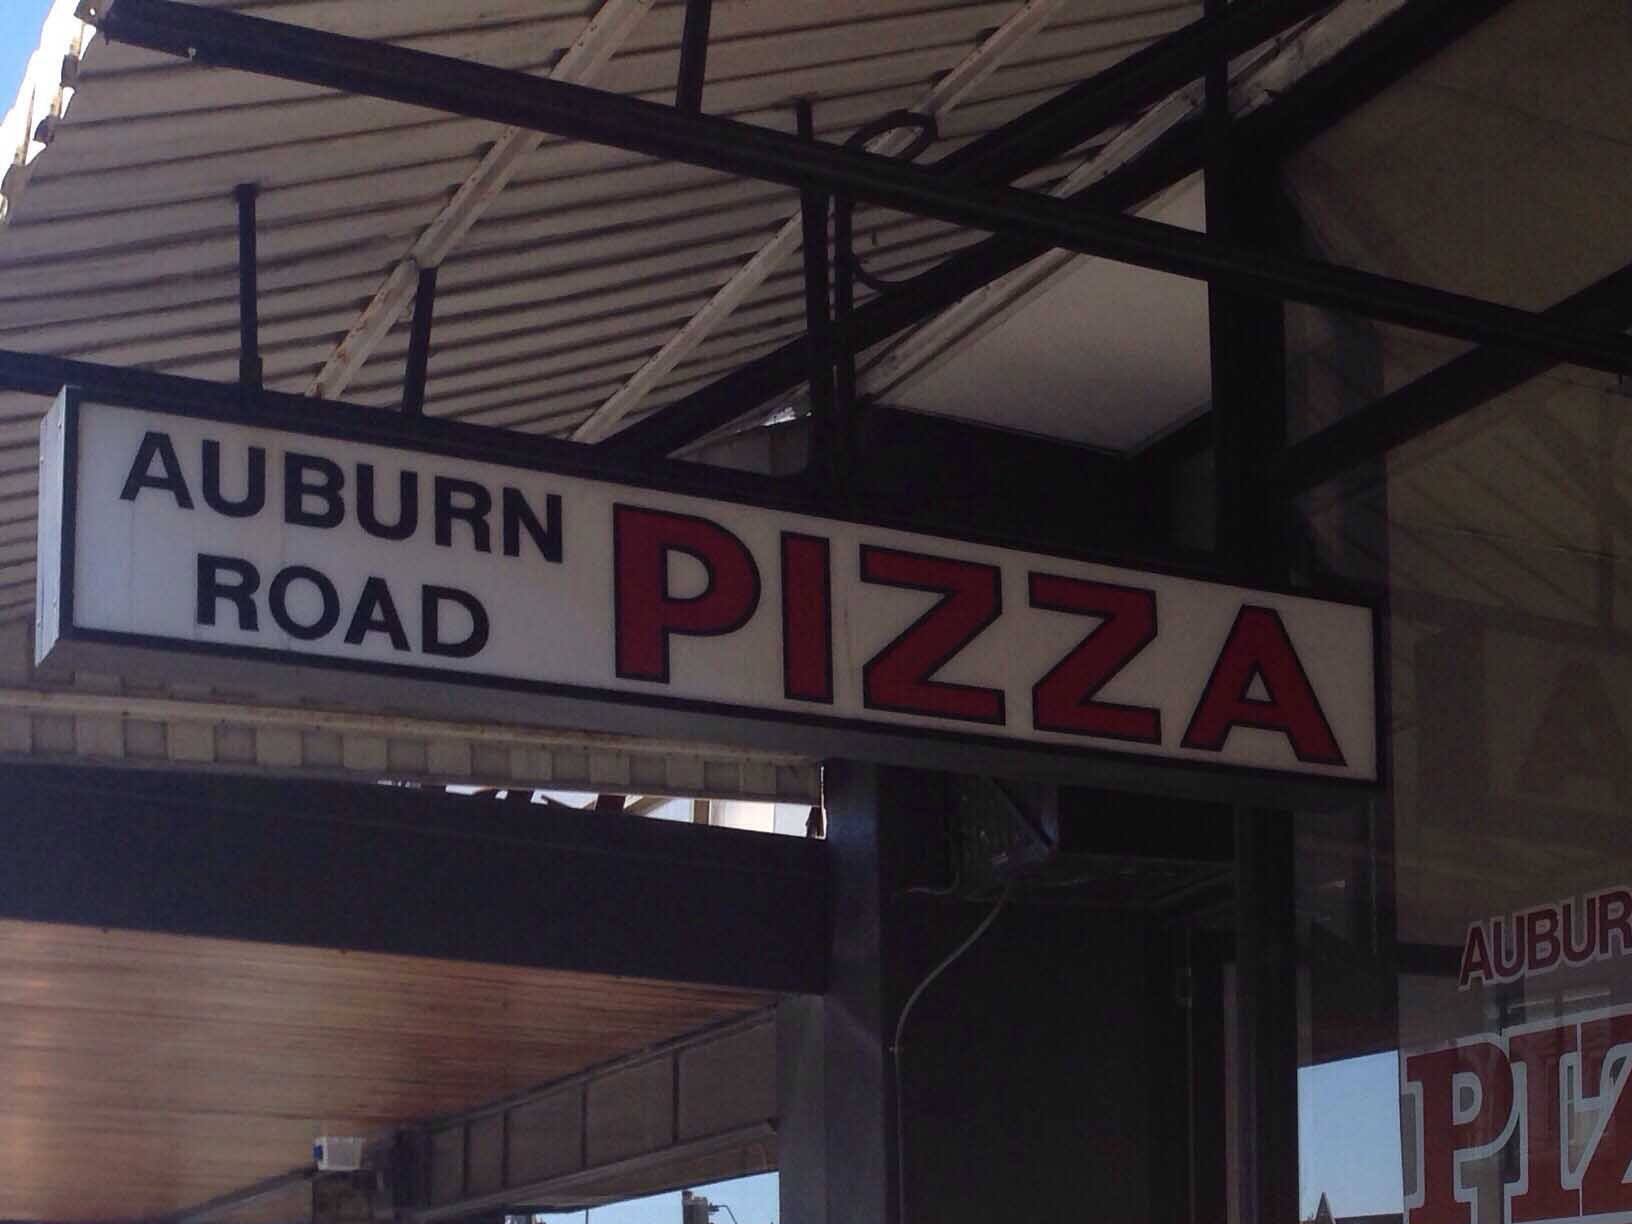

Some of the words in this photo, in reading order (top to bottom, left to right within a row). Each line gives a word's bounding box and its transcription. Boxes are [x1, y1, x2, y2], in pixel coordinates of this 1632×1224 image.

[118, 431, 564, 564] AUBURN
[197, 556, 489, 659] ROAD
[612, 502, 1346, 768] PIZZA
